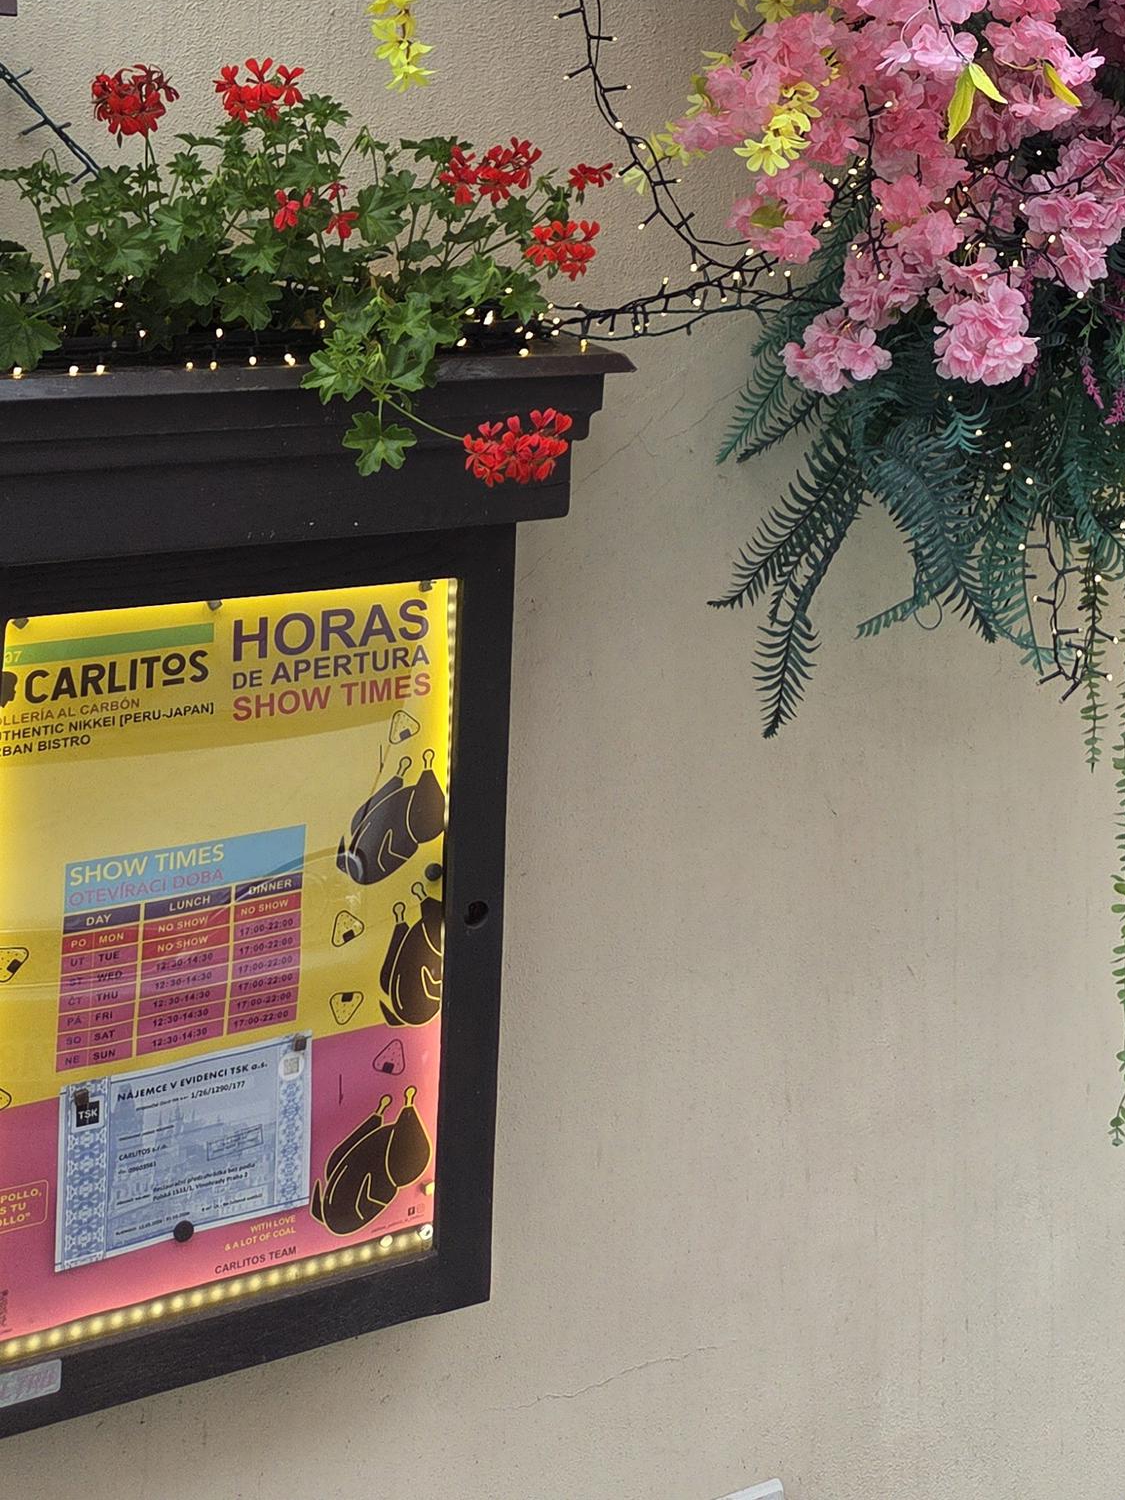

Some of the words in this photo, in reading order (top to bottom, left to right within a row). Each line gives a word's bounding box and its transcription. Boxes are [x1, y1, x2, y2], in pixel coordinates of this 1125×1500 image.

[233, 599, 430, 662] HORAS
[233, 670, 263, 690] DE
[271, 645, 430, 685] APERTURA
[25, 650, 209, 704] CARLITOS
[233, 685, 331, 722] SHOW
[340, 672, 431, 707] TIMES
[0, 707, 54, 726] LLERÍA
[57, 706, 76, 718] AL
[80, 697, 140, 715] CARBÓN
[0, 724, 64, 741] THENTIC
[69, 715, 116, 732] NIKKEI
[0, 742, 33, 757] BAN
[38, 735, 91, 752] BISTRO
[70, 855, 148, 887] SHOW
[155, 844, 225, 872] TIMES
[173, 868, 224, 890] DOBA
[249, 878, 293, 895] DINNER
[169, 895, 211, 912] LUNCH
[241, 905, 256, 916] NO
[258, 899, 289, 913] SHOW
[86, 913, 112, 926] DAY
[158, 922, 174, 933] NO
[177, 915, 209, 929] SHOW
[239, 918, 294, 937] 17:00-22:00
[71, 938, 87, 948] PO
[99, 932, 124, 944] MON
[157, 942, 173, 953] NO
[176, 935, 209, 949] SHOW
[239, 936, 294, 956] 17:00-22:00
[99, 951, 121, 962] TUE
[238, 955, 294, 975] 17:00-22:00
[96, 970, 123, 982] WED
[238, 973, 294, 991] 17:00-22:00
[96, 991, 119, 1002] THU
[95, 1011, 113, 1021] FRI
[152, 1008, 209, 1028] 12:30-14:30
[94, 1030, 116, 1041] SAT
[152, 1027, 208, 1047] 12:30-14:30
[93, 1049, 116, 1061] SUN
[170, 1080, 178, 1090] V
[180, 1068, 227, 1087] EVIDENCI
[230, 1063, 249, 1076] TSK
[78, 1108, 98, 1120] TSK
[118, 1147, 151, 1161] CARLITOS
[10, 1202, 27, 1213] TU
[250, 1221, 272, 1233] WITH
[274, 1215, 296, 1227] LOVE
[232, 1241, 240, 1249] A
[241, 1235, 258, 1247] LOT
[259, 1232, 271, 1242] OF
[273, 1227, 297, 1238] COAL
[214, 1254, 266, 1275] CARLITOS
[269, 1246, 297, 1261] TEAM
